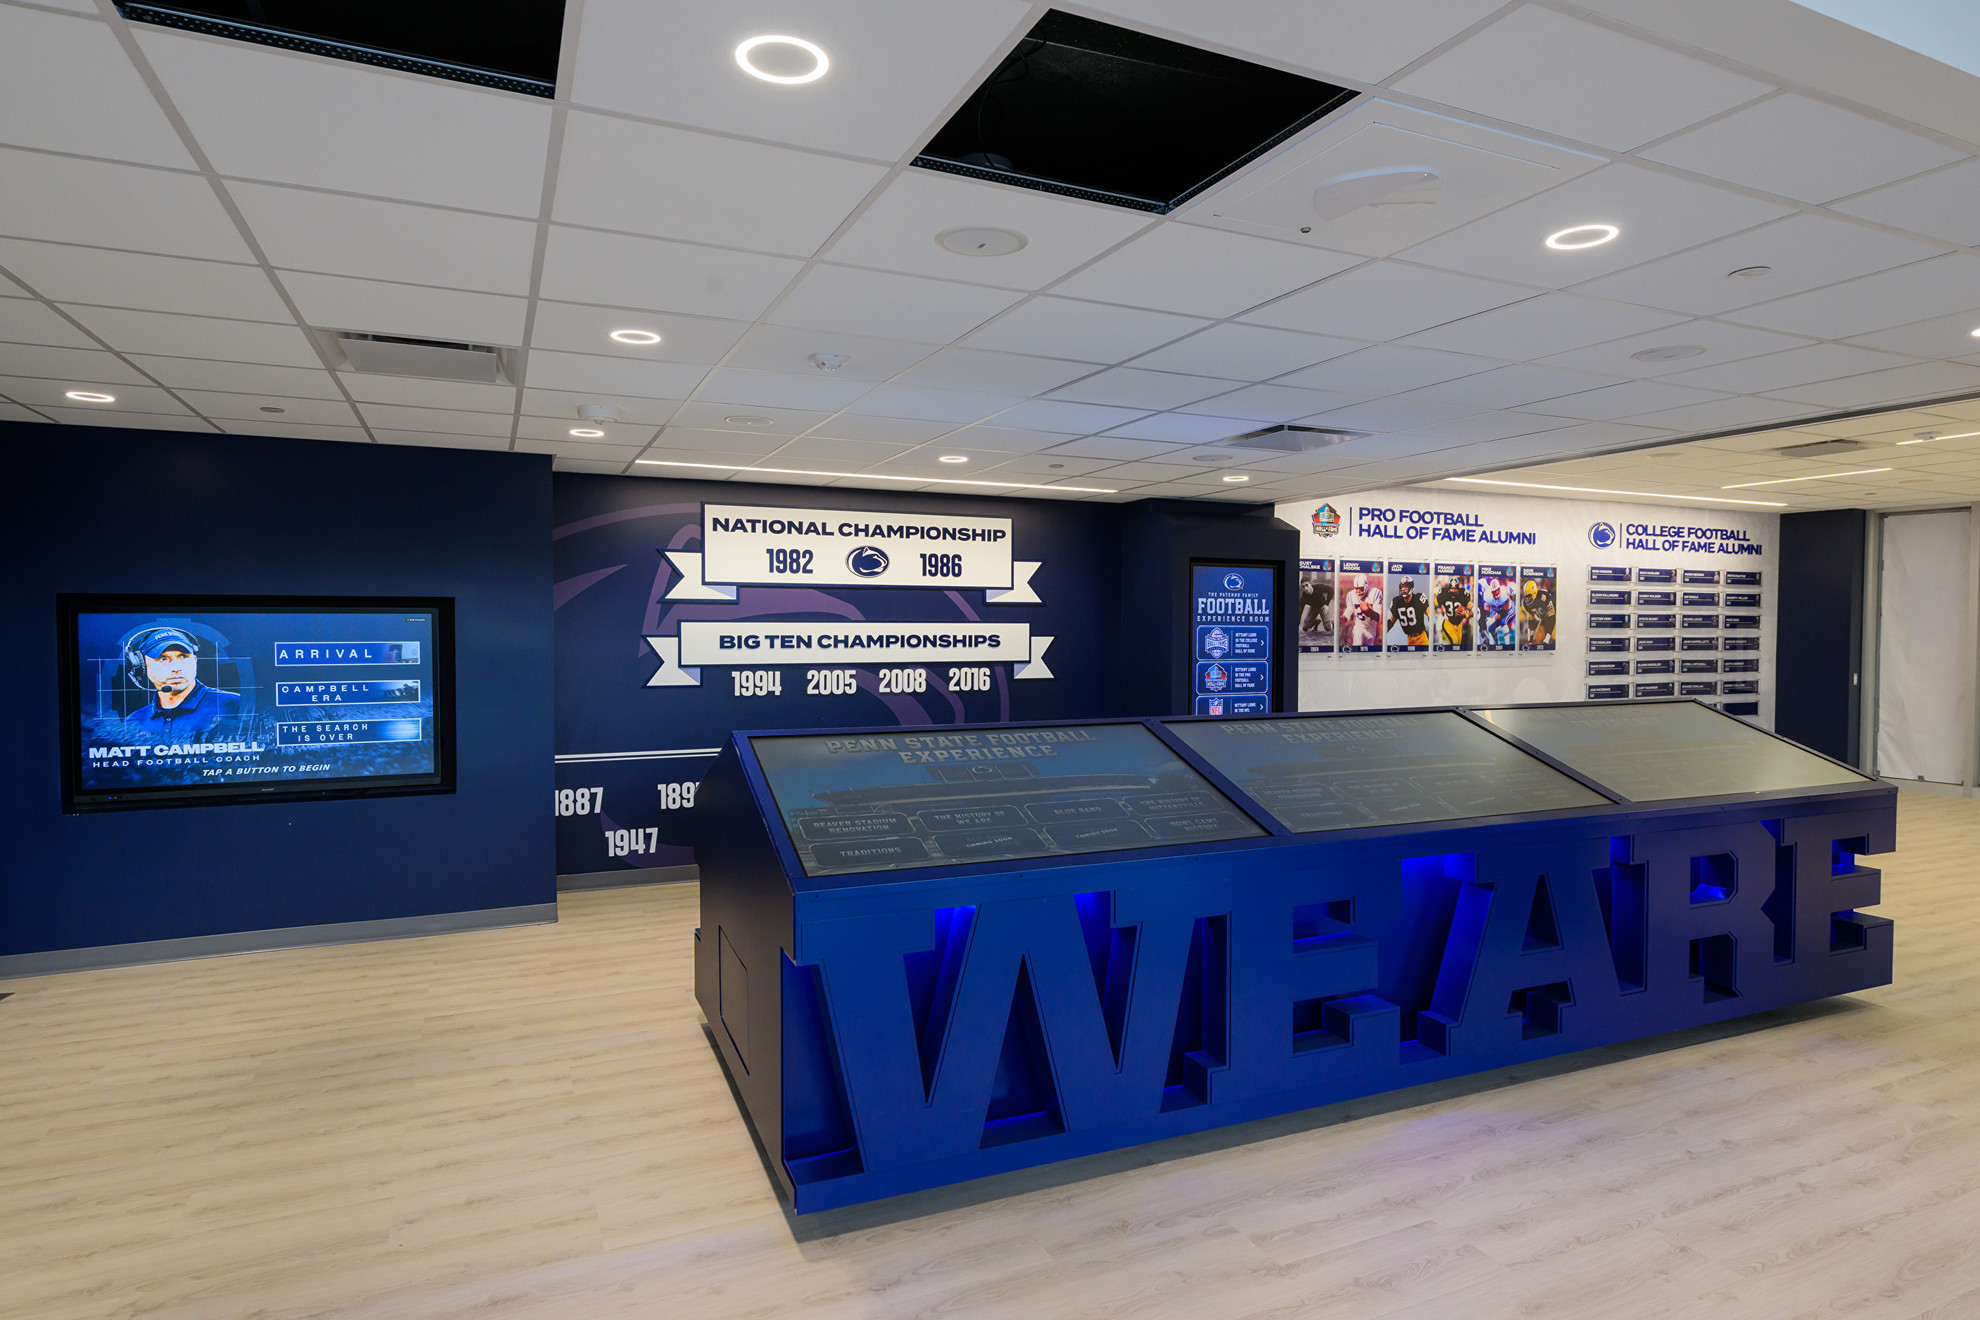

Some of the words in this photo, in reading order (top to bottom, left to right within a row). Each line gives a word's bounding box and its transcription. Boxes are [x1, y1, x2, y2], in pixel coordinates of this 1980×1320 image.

[1359, 507, 1396, 522] PRO
[1399, 509, 1484, 528] FOOTBALL
[712, 517, 834, 537] NATIONAL
[838, 522, 1006, 542] CHAMPIONSHIP
[1359, 523, 1404, 539] HALL
[1406, 526, 1429, 540] OF
[1432, 527, 1476, 543] FAME
[1478, 530, 1536, 545] ALUMNI
[1626, 523, 1685, 539] COLLEGE
[1687, 527, 1750, 542] FOOTBALL
[1626, 538, 1661, 551] HALL
[1662, 540, 1679, 552] OF
[1682, 540, 1716, 554] FAME
[1717, 543, 1762, 555] ALUMNI
[766, 549, 814, 574] 1982
[920, 553, 962, 578] 1986
[1198, 598, 1270, 615] FOOTBALL
[1397, 606, 1417, 627] 59
[719, 635, 762, 650] BIG
[765, 635, 812, 649] TEN
[816, 634, 1001, 649] CHAMPIONSHIPS
[279, 649, 372, 659] ARRIVAL
[281, 684, 369, 693] CAMPBELL
[732, 671, 782, 696] 1994
[807, 670, 857, 695] 2005
[879, 669, 927, 693] 2008
[948, 668, 991, 692] 2016
[312, 694, 342, 702] ERA
[1211, 706, 1221, 715] NFL
[282, 725, 307, 733] THE
[316, 723, 368, 732] SEARCH
[1219, 723, 1278, 735] PENN
[1278, 720, 1338, 732] STATE
[1282, 728, 1403, 744] EXPERIENCE
[319, 733, 353, 741] OVER
[825, 738, 897, 753] PENN
[903, 734, 983, 750] STATE
[983, 730, 1098, 747] FOOTBALL
[89, 745, 151, 758] MATT
[153, 741, 264, 757] CAMPBELL
[898, 745, 1059, 764] EXPERIENCE
[93, 760, 130, 768] HEAD
[137, 757, 208, 767] FOOTBALL
[216, 754, 261, 763] COACH
[202, 769, 222, 777] TAP
[224, 768, 233, 776] A
[236, 766, 278, 775] BUTTON
[282, 765, 296, 773] TO
[299, 763, 331, 772] BEGIN
[555, 787, 603, 816] 1887
[657, 781, 700, 810] 189
[813, 820, 852, 828] BEAVER
[854, 818, 897, 826] STADIUM
[828, 824, 889, 833] RENOVATION
[605, 827, 658, 857] 1947
[839, 847, 902, 857] TRADITIONS
[797, 862, 1400, 1175] WE
[1446, 806, 1897, 1060] ARE
